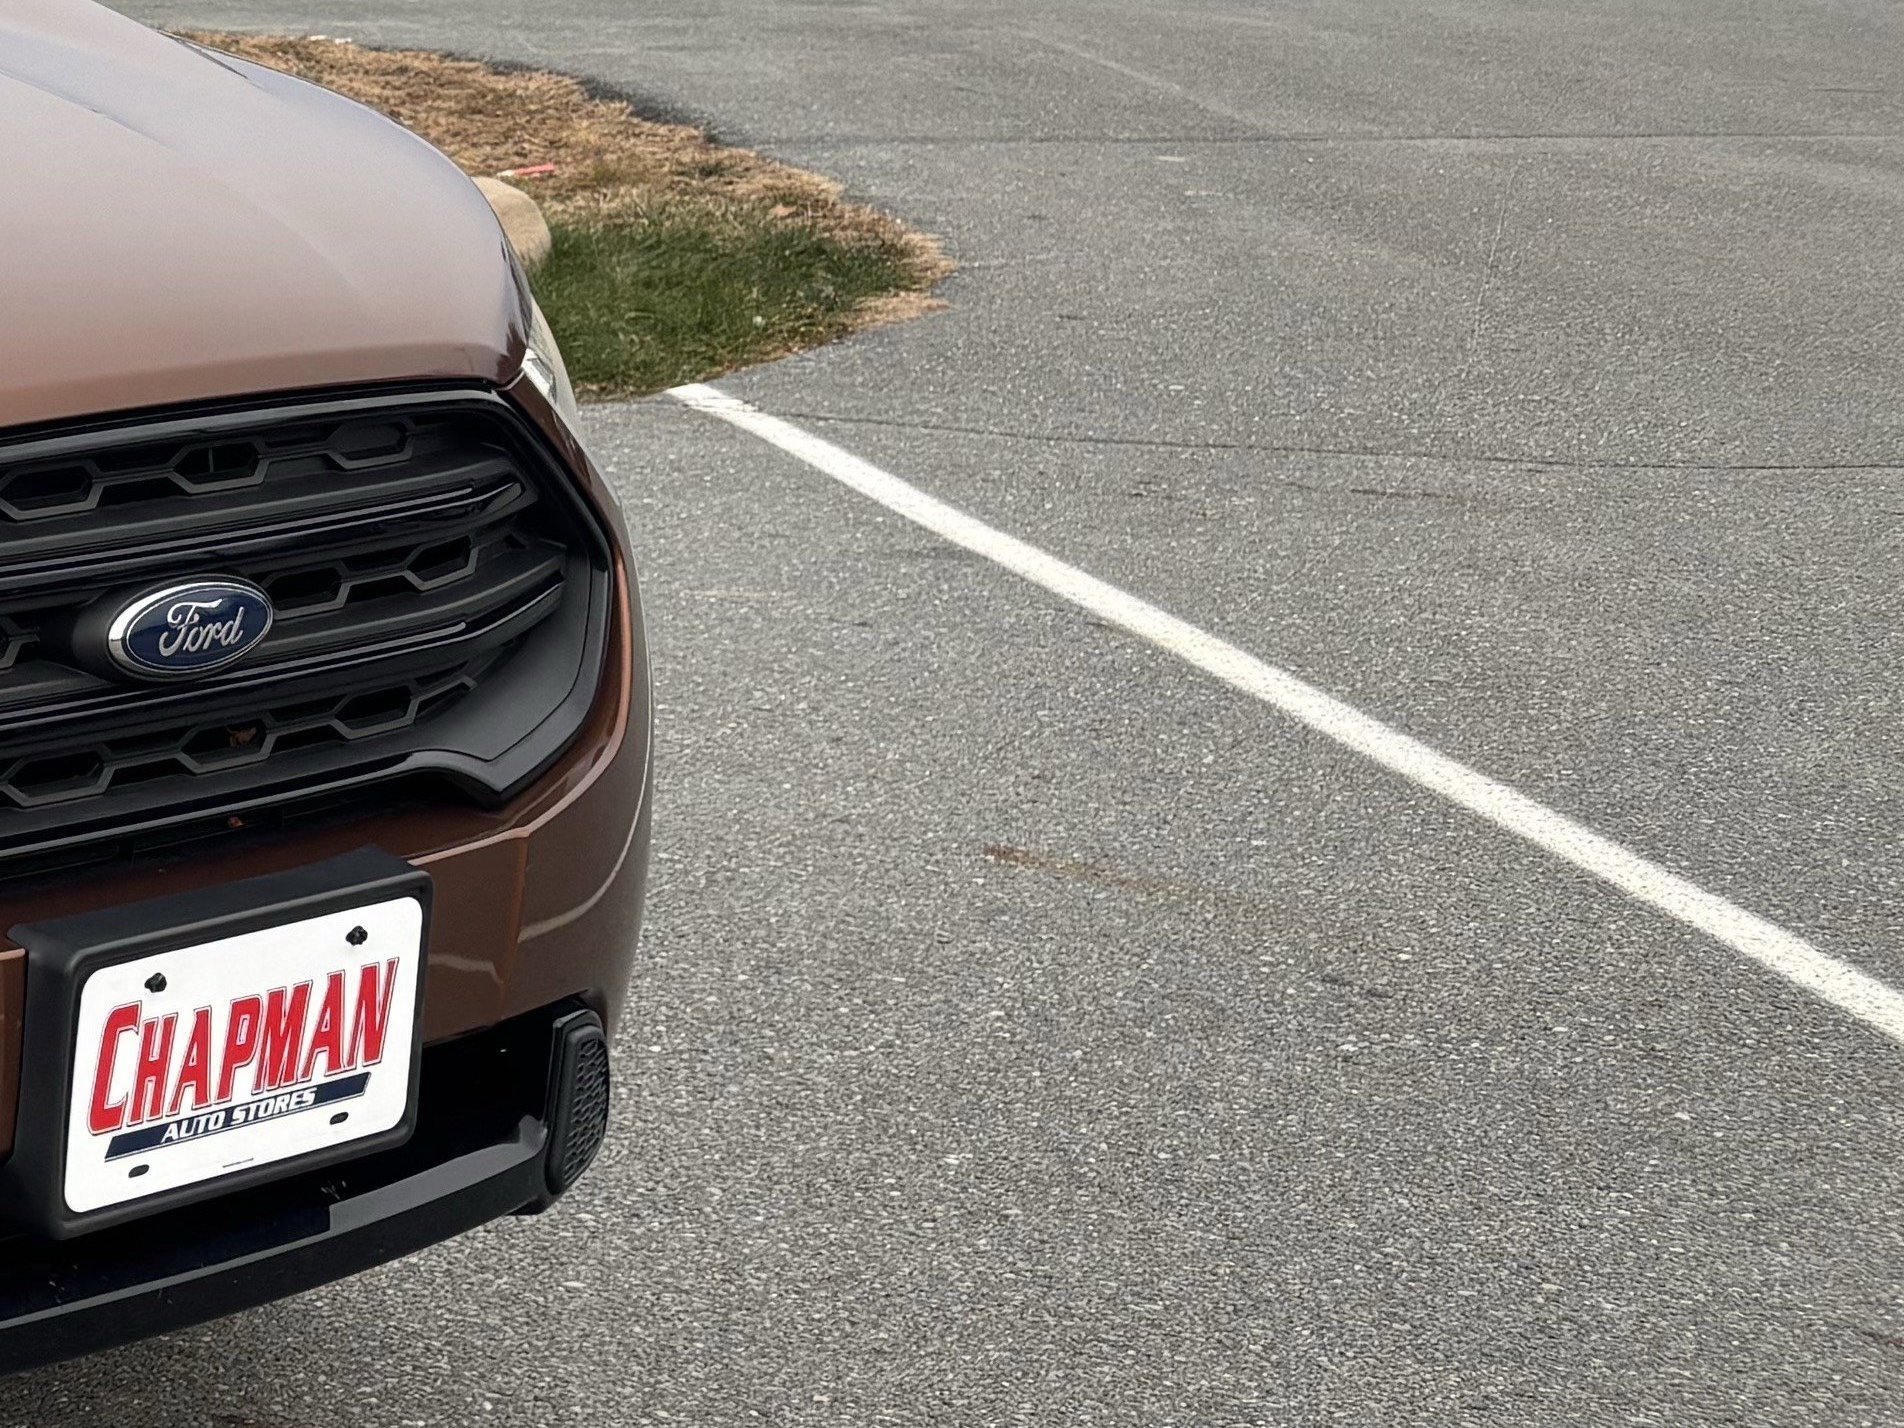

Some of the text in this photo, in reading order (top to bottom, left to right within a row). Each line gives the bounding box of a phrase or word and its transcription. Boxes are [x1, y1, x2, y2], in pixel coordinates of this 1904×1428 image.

[158, 597, 245, 657] Ford
[88, 957, 400, 1136] CHAPMAN
[160, 1087, 318, 1144] AUTO STORES
